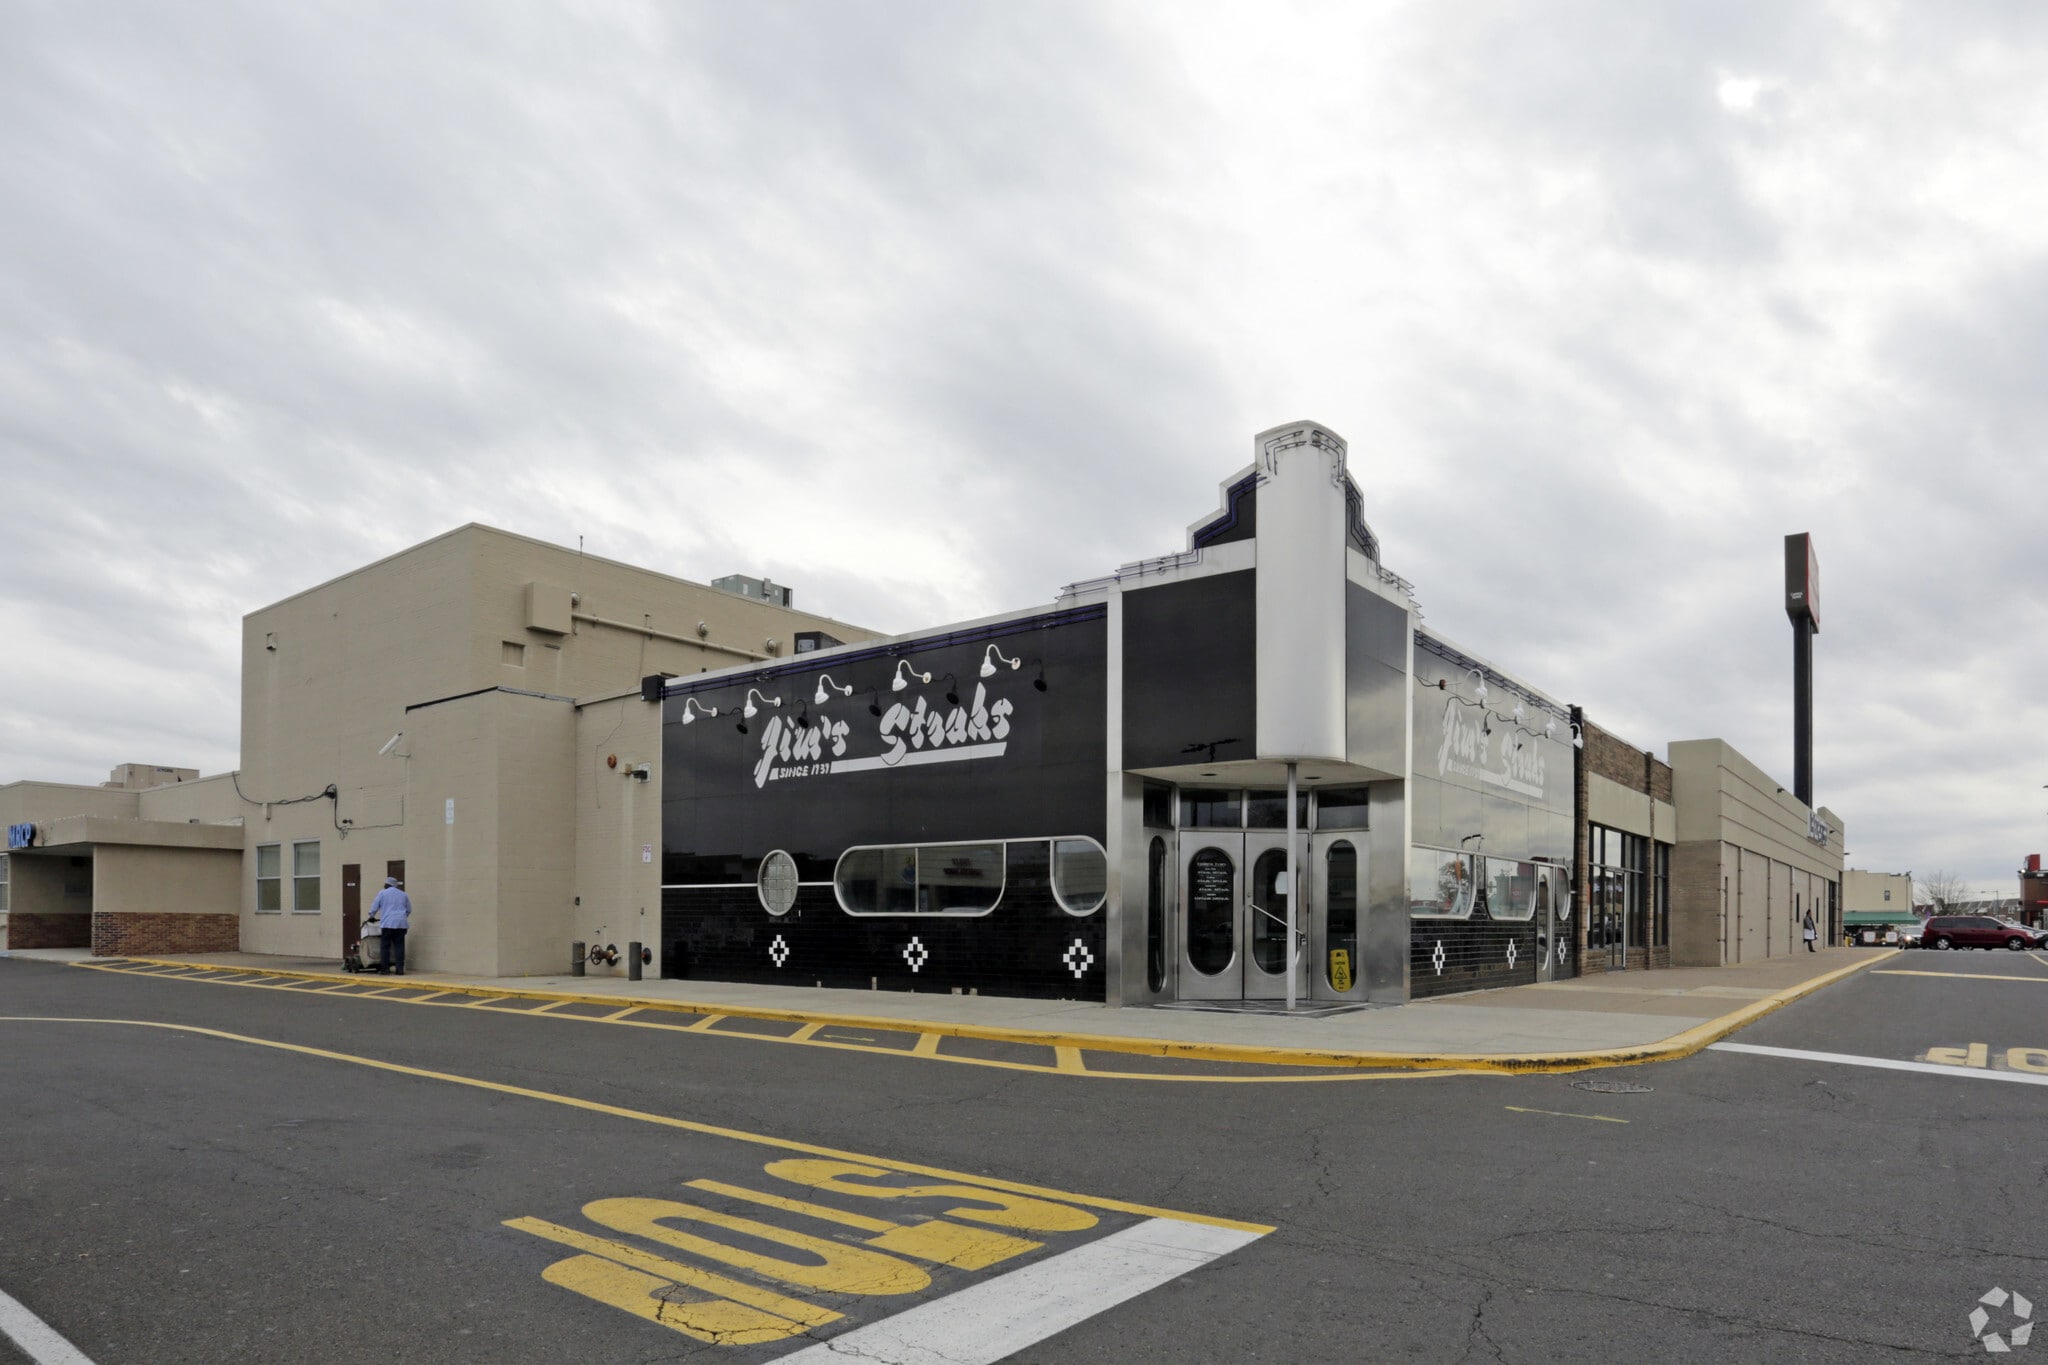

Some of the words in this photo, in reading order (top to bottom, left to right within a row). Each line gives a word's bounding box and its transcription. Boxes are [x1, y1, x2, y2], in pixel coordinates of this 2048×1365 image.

[753, 715, 850, 789] Jim's
[879, 682, 1013, 766] Steaks
[779, 765, 809, 778] SINCE
[500, 1157, 1098, 1347] STOP
